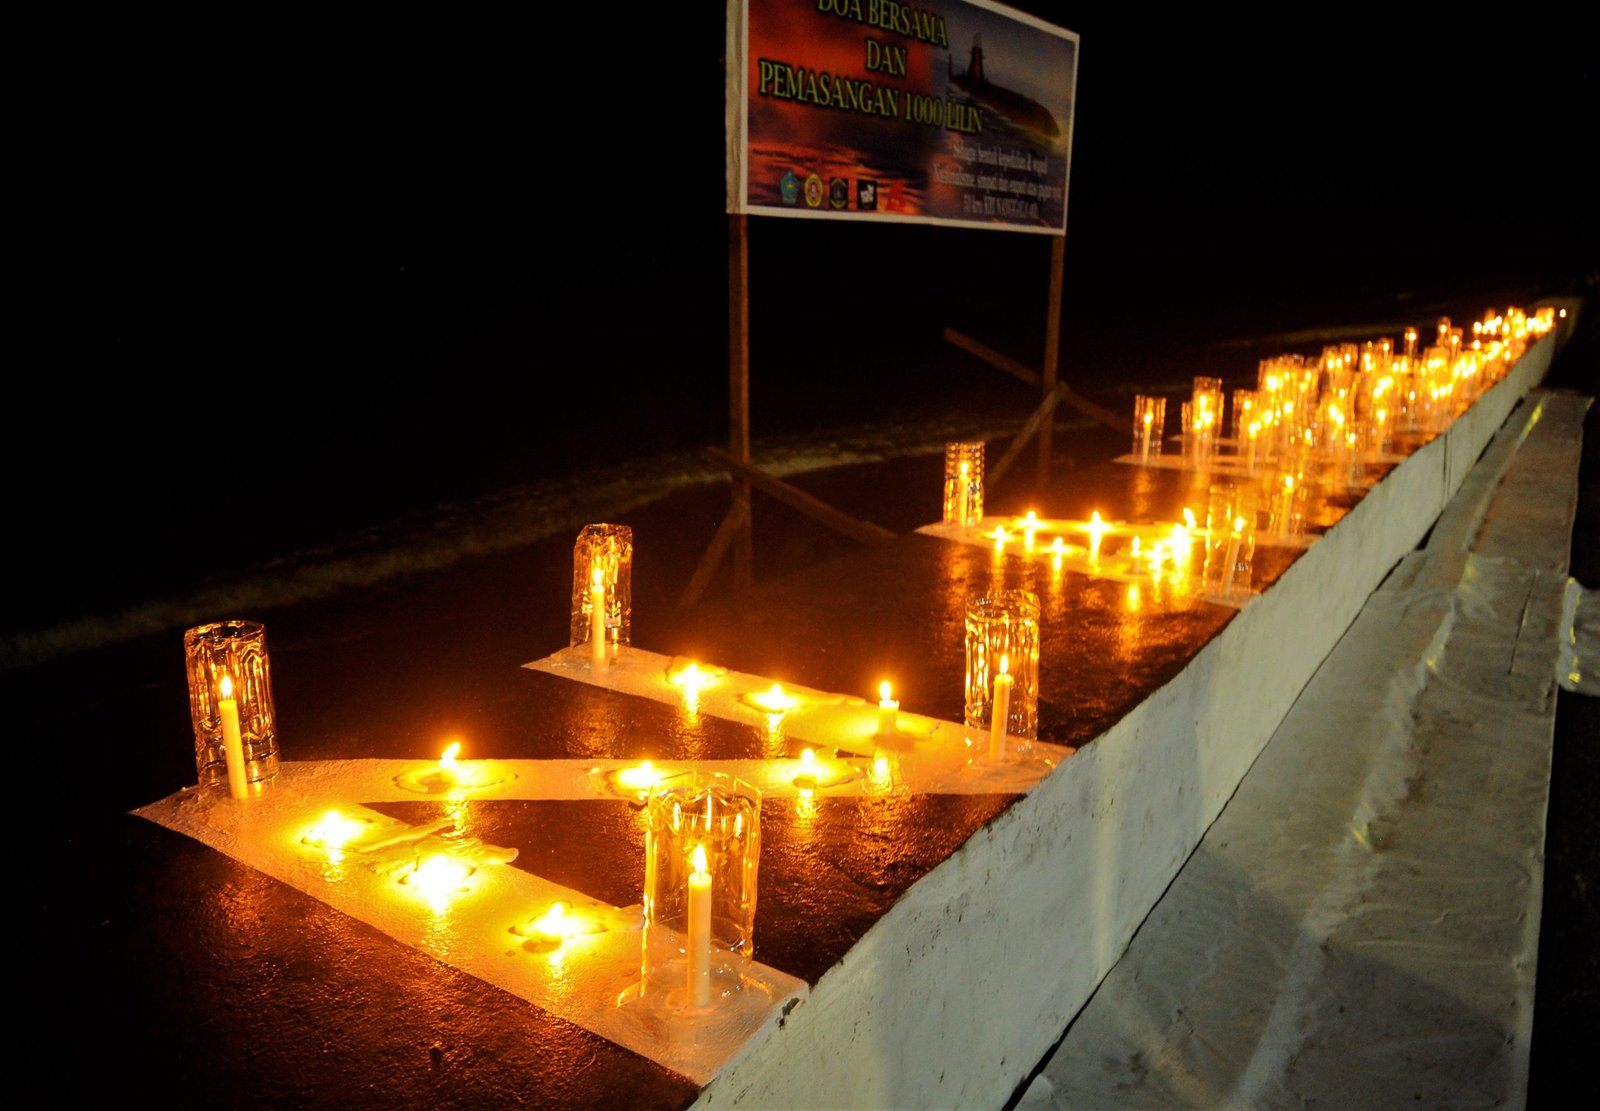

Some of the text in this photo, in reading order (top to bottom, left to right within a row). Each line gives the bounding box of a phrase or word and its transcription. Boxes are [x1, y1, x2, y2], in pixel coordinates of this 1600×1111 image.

[868, 0, 949, 47] BERSAMA
[866, 39, 907, 76] DAN
[759, 61, 983, 133] PEMASANGAN 1000 LILIN
